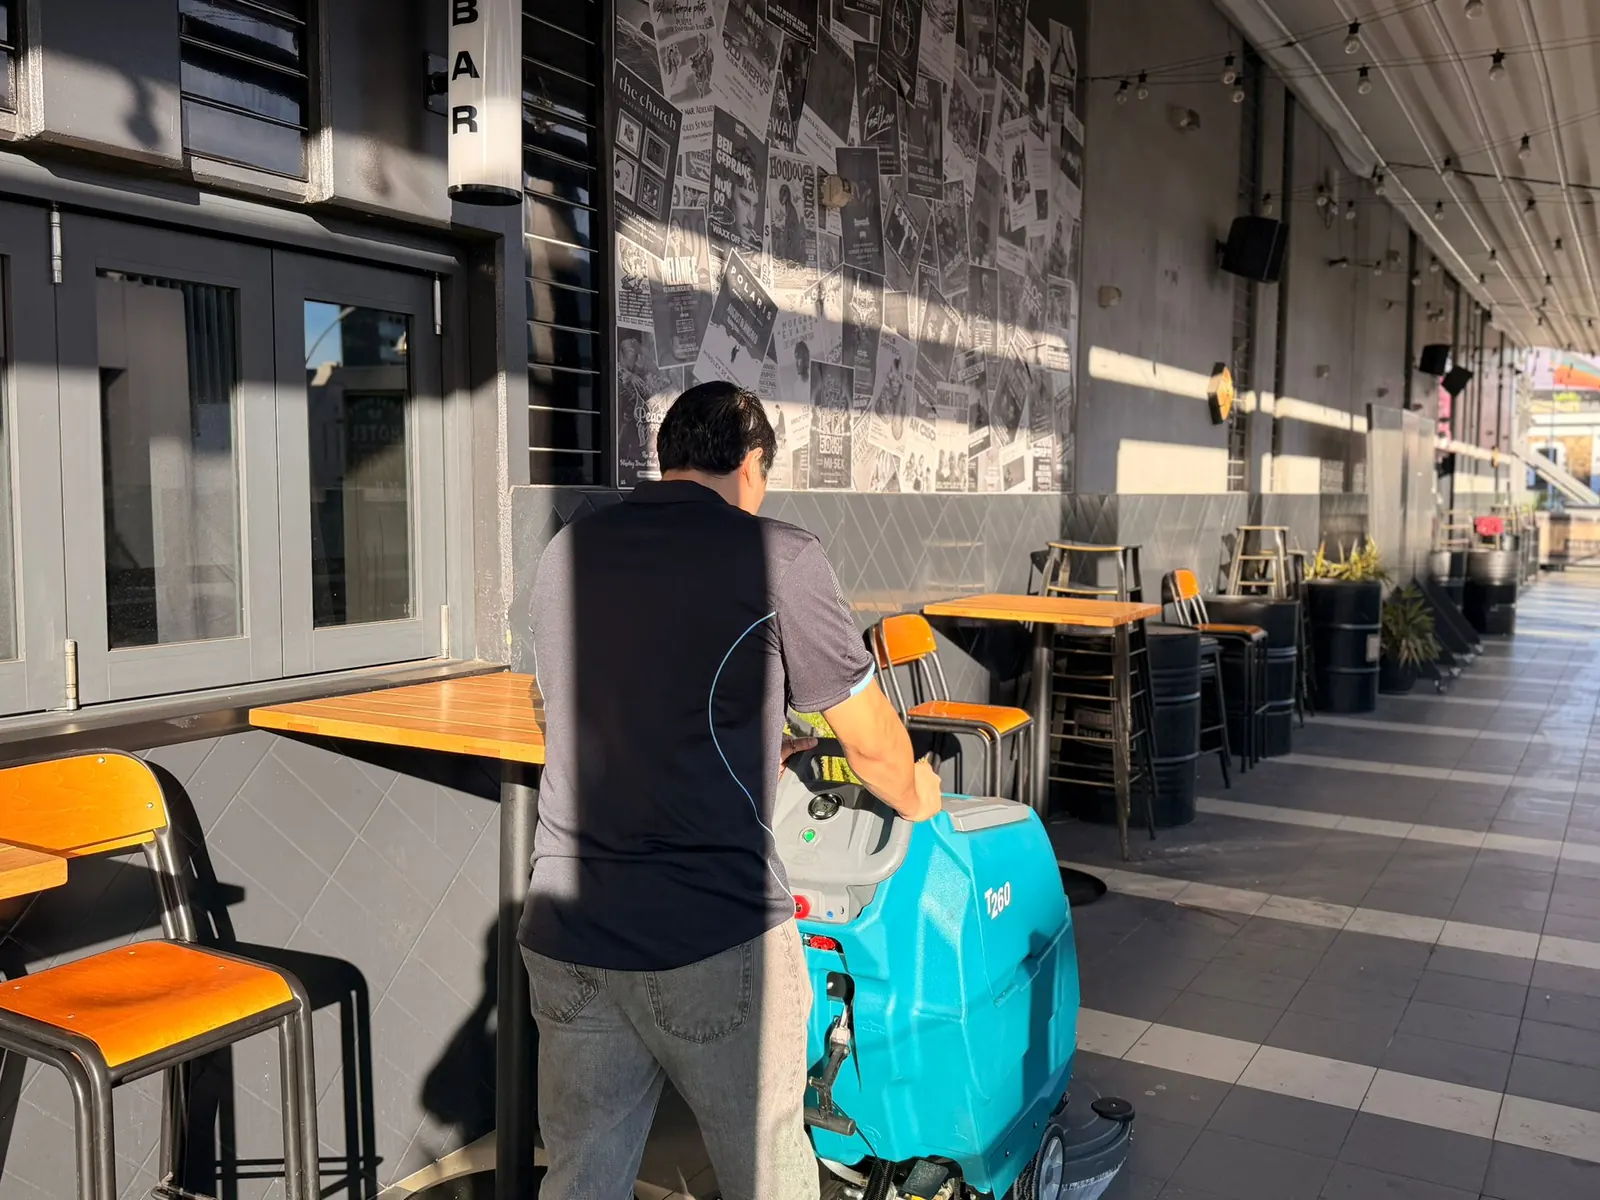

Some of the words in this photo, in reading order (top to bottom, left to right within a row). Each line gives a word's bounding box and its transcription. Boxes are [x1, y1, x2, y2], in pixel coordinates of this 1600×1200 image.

[451, 0, 480, 135] BAR
[619, 77, 638, 100] the
[639, 94, 676, 131] church
[716, 134, 733, 155] BEN
[769, 155, 803, 182] HOODOO
[713, 190, 725, 206] 09
[730, 265, 772, 321] POLARIS
[984, 881, 1011, 921] T260
